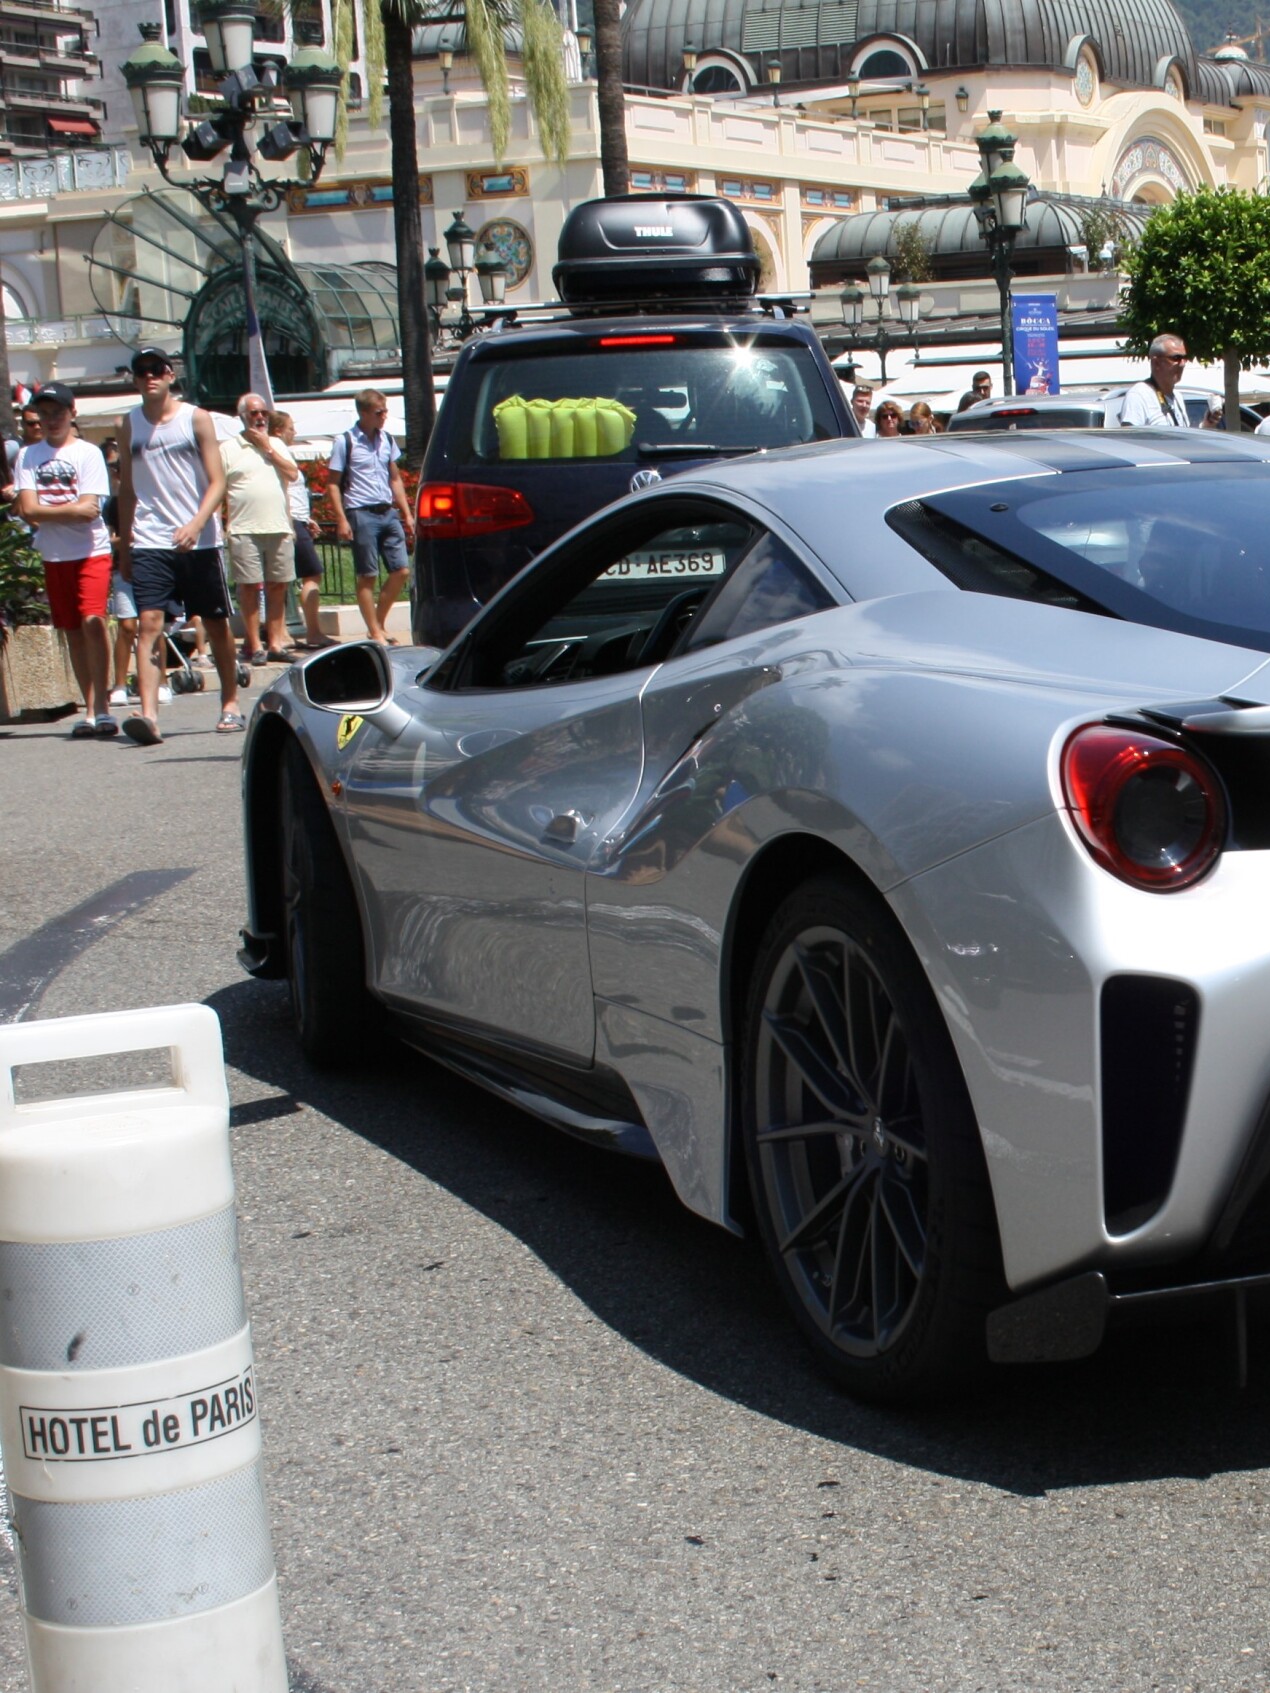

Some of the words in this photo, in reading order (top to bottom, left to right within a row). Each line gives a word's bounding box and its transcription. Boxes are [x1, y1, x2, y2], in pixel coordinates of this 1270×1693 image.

[634, 226, 674, 237] THULE
[28, 1413, 131, 1455] HOTEL
[142, 1409, 181, 1448] de
[190, 1376, 254, 1437] PARIS
